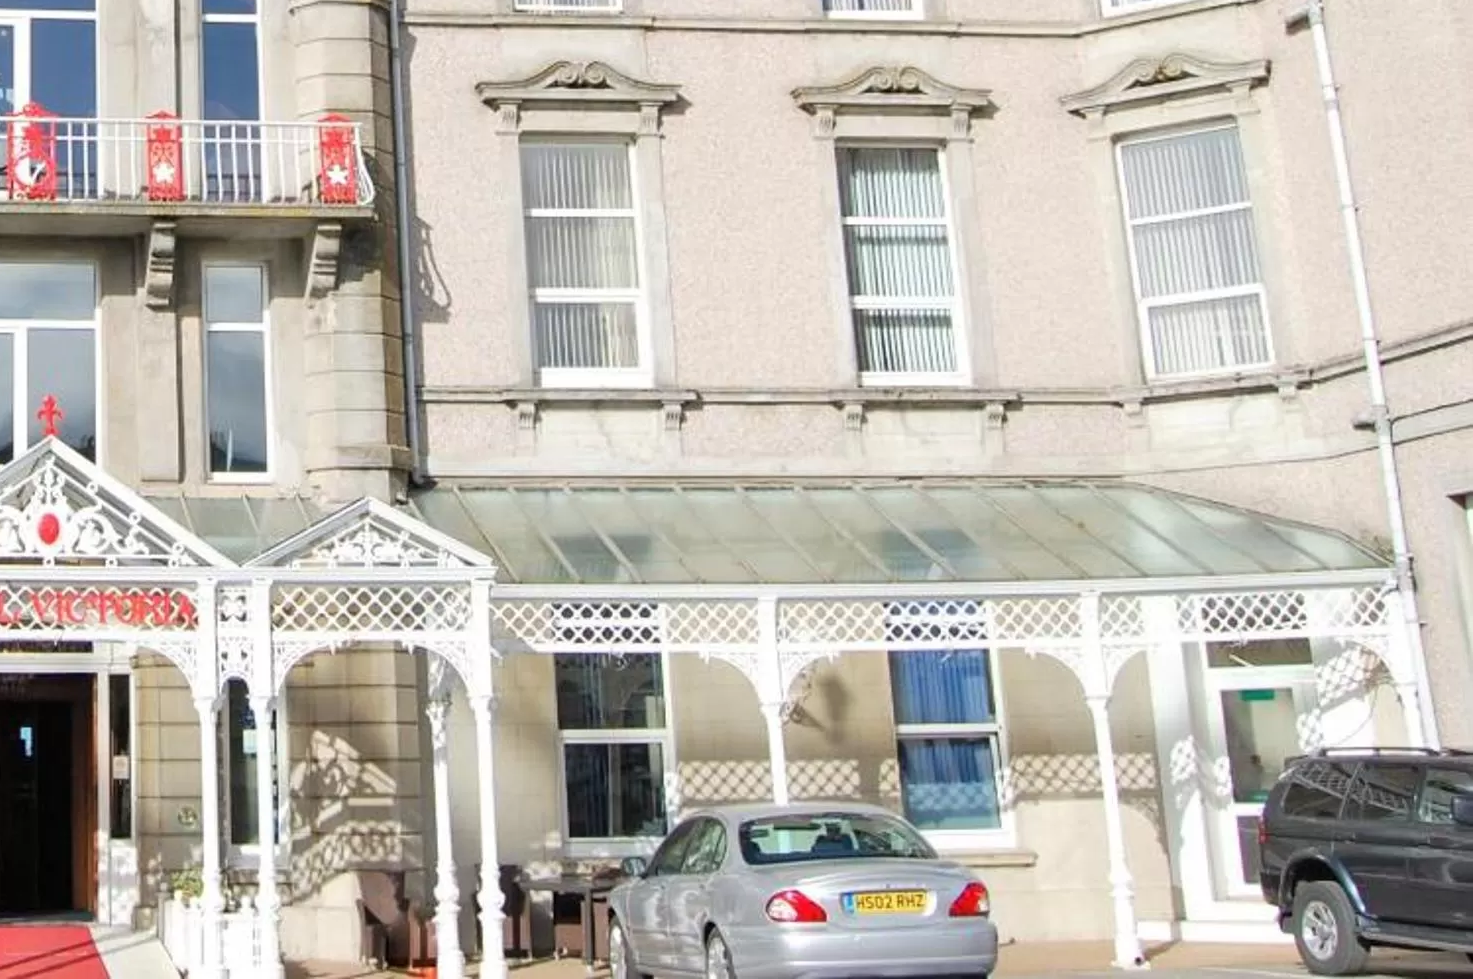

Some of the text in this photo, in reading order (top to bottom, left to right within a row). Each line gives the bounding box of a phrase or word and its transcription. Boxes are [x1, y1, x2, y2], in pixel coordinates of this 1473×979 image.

[30, 588, 199, 626] VICTORIA
[857, 893, 926, 909] HS02 RHZ
